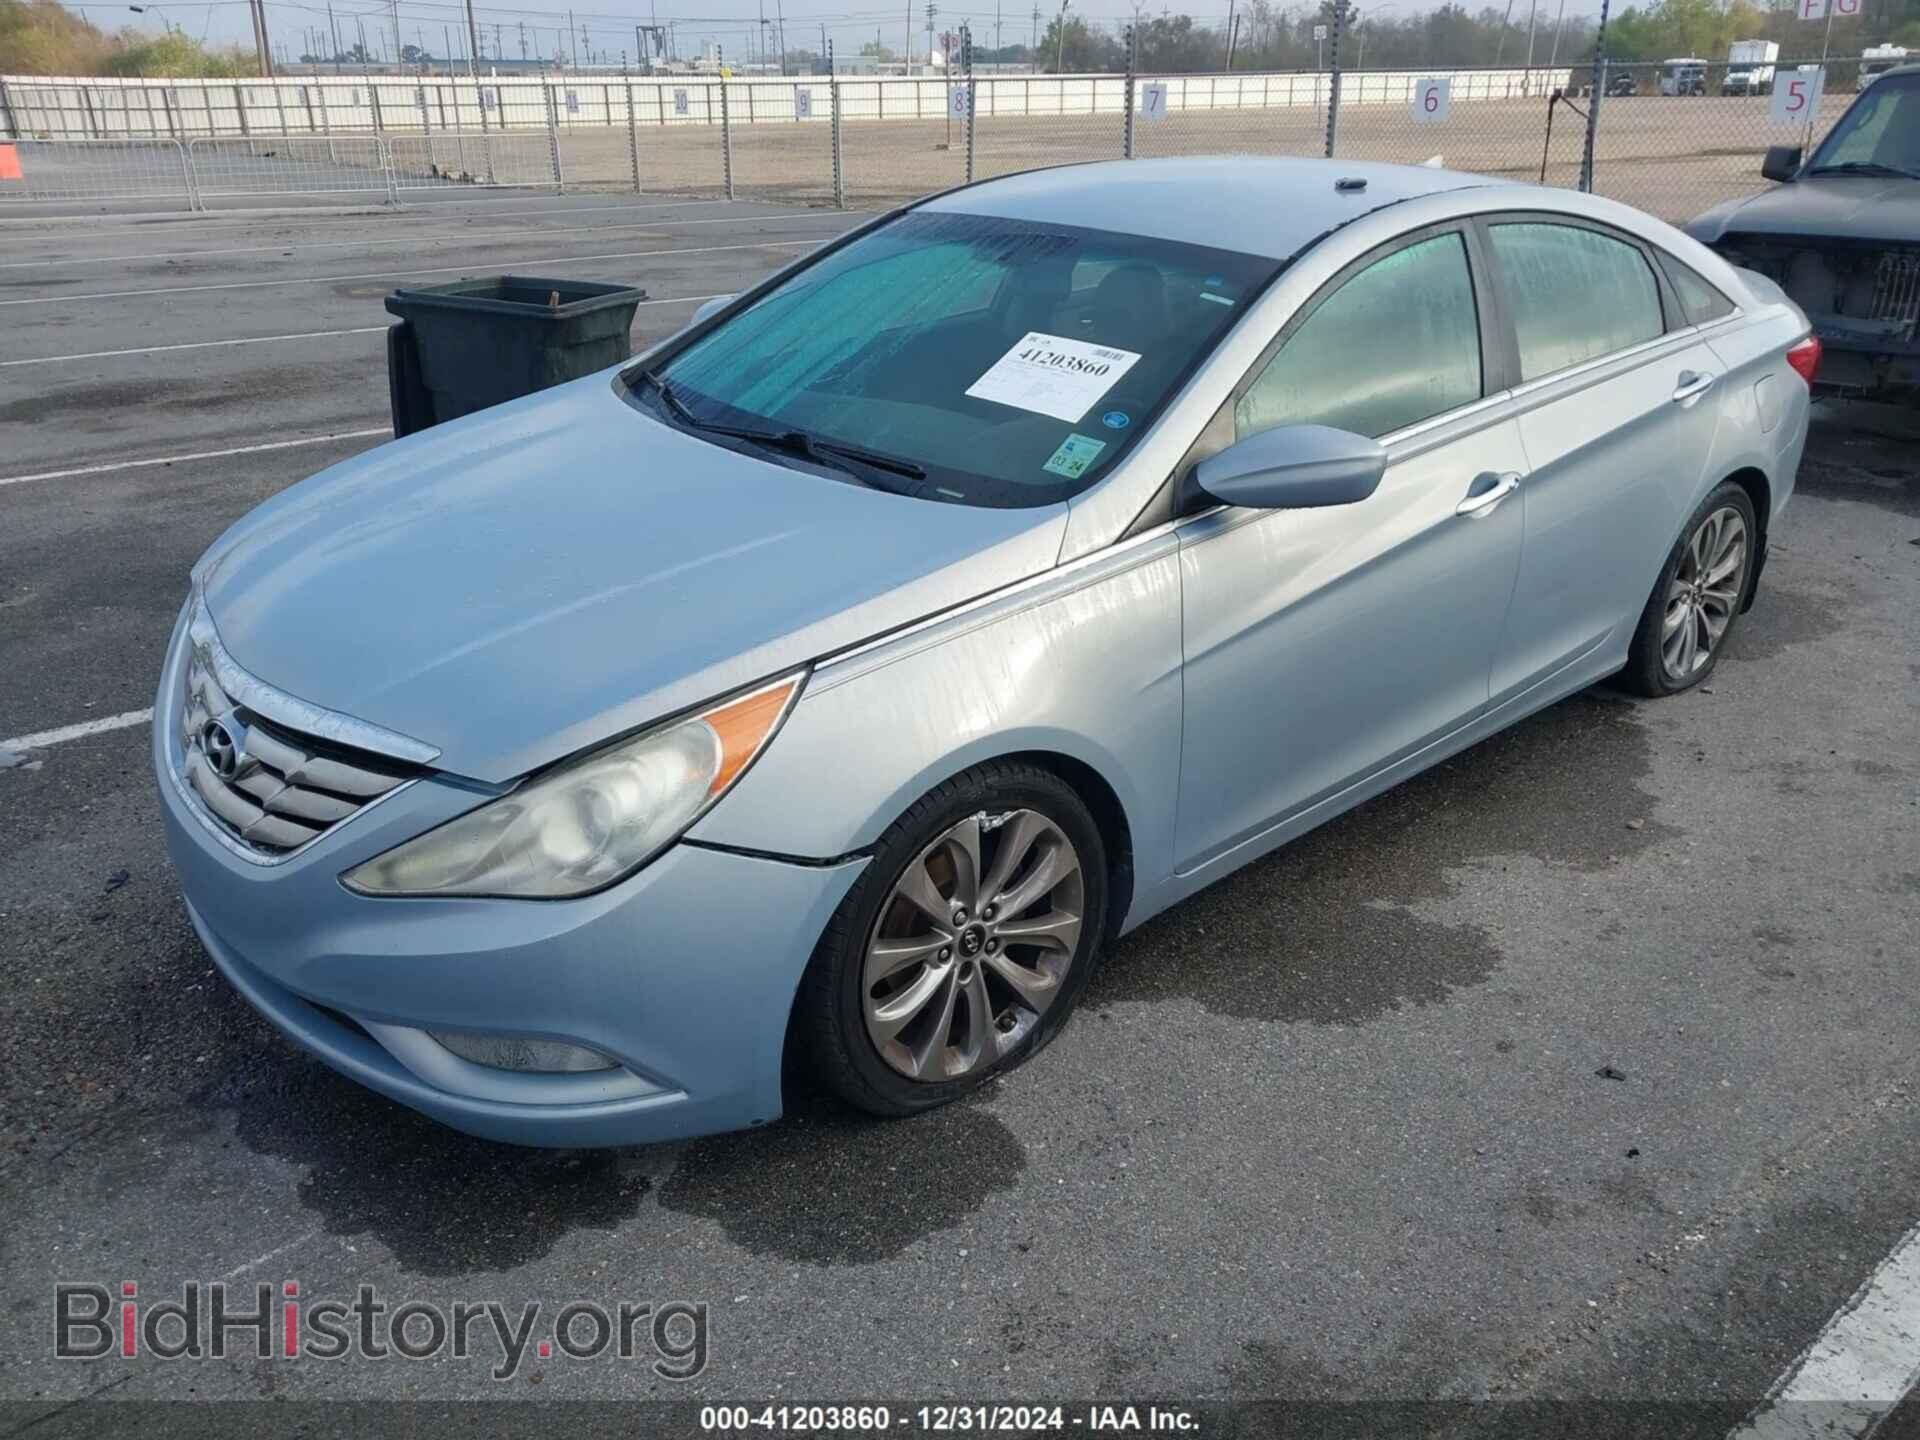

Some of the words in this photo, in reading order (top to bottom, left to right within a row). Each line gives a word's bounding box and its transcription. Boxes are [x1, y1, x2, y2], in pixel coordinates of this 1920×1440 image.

[800, 94, 808, 113] 9
[954, 92, 964, 112] 8
[1149, 90, 1160, 112] 7
[1424, 86, 1439, 113] 6
[1784, 80, 1806, 112] 5
[1019, 347, 1111, 377] 41203860
